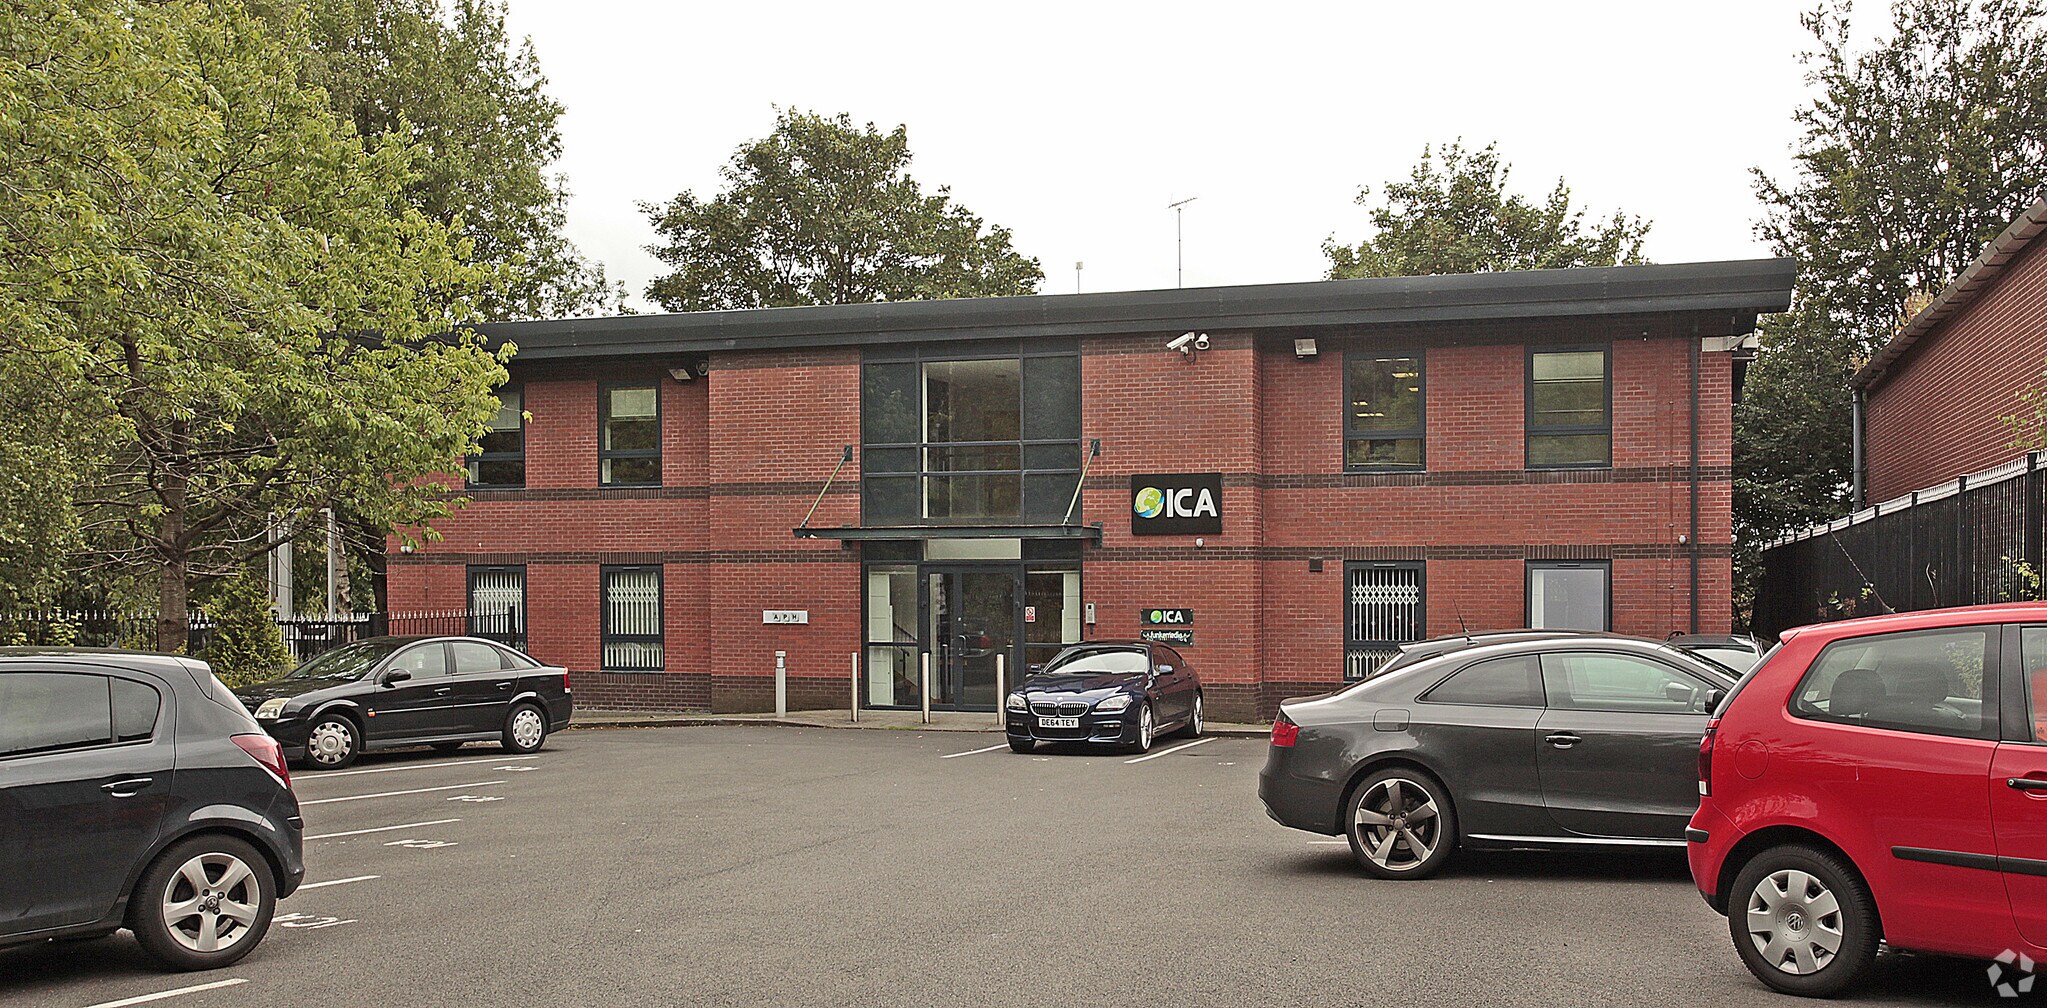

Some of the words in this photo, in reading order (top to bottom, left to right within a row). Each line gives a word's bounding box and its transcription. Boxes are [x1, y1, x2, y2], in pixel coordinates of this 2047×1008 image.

[1166, 488, 1218, 518] ICA
[1162, 610, 1184, 623] ICA
[1041, 719, 1059, 727] DE64
[1061, 719, 1076, 727] TEY
